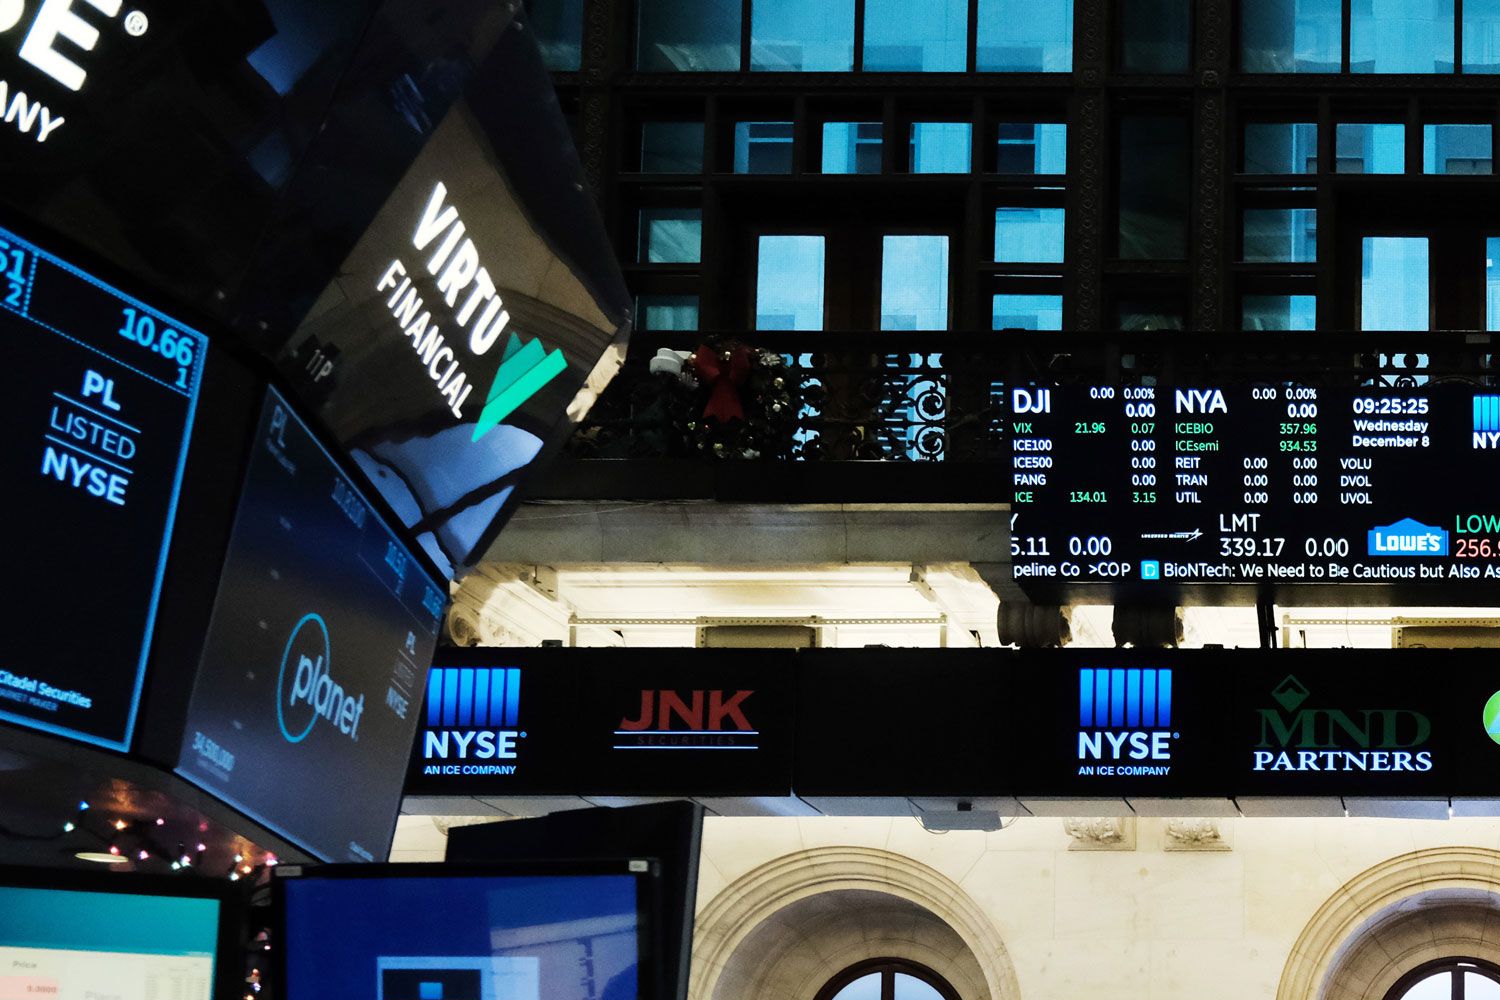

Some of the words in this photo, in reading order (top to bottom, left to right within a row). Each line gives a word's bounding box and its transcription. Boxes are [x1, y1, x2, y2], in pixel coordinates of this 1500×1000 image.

[413, 181, 510, 356] VIRTU
[118, 307, 195, 366] 10.66
[376, 259, 473, 419] FINANCIAL
[175, 367, 188, 389] 1
[82, 369, 121, 411] PL
[1012, 388, 1050, 413] DJI
[1175, 389, 1227, 413] NYA
[1353, 398, 1428, 414] 09:25:25
[50, 406, 136, 460] LISTED
[1013, 423, 1032, 433] VIX
[1075, 423, 1105, 433] 21.96
[1132, 423, 1154, 433] 0.07
[1176, 423, 1213, 433] ICEBIO
[1280, 423, 1317, 434] 357.96
[1354, 420, 1428, 433] Wednesday
[1013, 438, 1052, 451] ICE100
[1176, 440, 1218, 451] ICEsemi
[1280, 441, 1316, 451] 934.53
[1353, 435, 1418, 447] December
[1422, 436, 1429, 447] 8
[1014, 456, 1052, 468] ICE500
[1176, 457, 1200, 468] REIT
[1340, 458, 1371, 469] VOLU
[42, 446, 129, 506] NYSE
[1014, 473, 1046, 485] FANG
[1176, 474, 1207, 485] TRAN
[1341, 475, 1372, 487] DVOL
[1015, 492, 1033, 502] ICE
[1071, 492, 1107, 502] 134.01
[1133, 492, 1156, 503] 3.15
[1176, 492, 1201, 503] UTIL
[1341, 493, 1372, 504] UVOL
[1220, 514, 1260, 532] LMT
[1069, 536, 1111, 555] 0.00
[1220, 538, 1285, 556] 339.17
[1306, 538, 1348, 557] 0.00
[1376, 533, 1442, 551] LOWE'S
[1014, 563, 1056, 578] peline
[1061, 562, 1080, 576] Co
[1164, 563, 1235, 577] BioNTech:
[1240, 564, 1263, 577] We
[1268, 563, 1304, 577] Need
[1309, 564, 1324, 577] to
[1329, 563, 1349, 577] Be
[1353, 564, 1415, 578] Cautious
[1420, 564, 1444, 578] but
[1448, 564, 1480, 578] Also
[38, 682, 92, 709] Securities
[291, 655, 364, 739] planet
[617, 690, 756, 732] JNK
[1254, 709, 1431, 748] MND
[423, 731, 517, 758] NYSE
[1078, 732, 1170, 759] NYSE
[1253, 751, 1432, 771] PARTNERS
[424, 766, 442, 774] AN
[442, 766, 460, 774] ICE
[462, 766, 516, 774] COMPANY
[1079, 766, 1094, 775] AN
[1097, 766, 1114, 775] ICE
[1117, 766, 1170, 775] COMPANY
